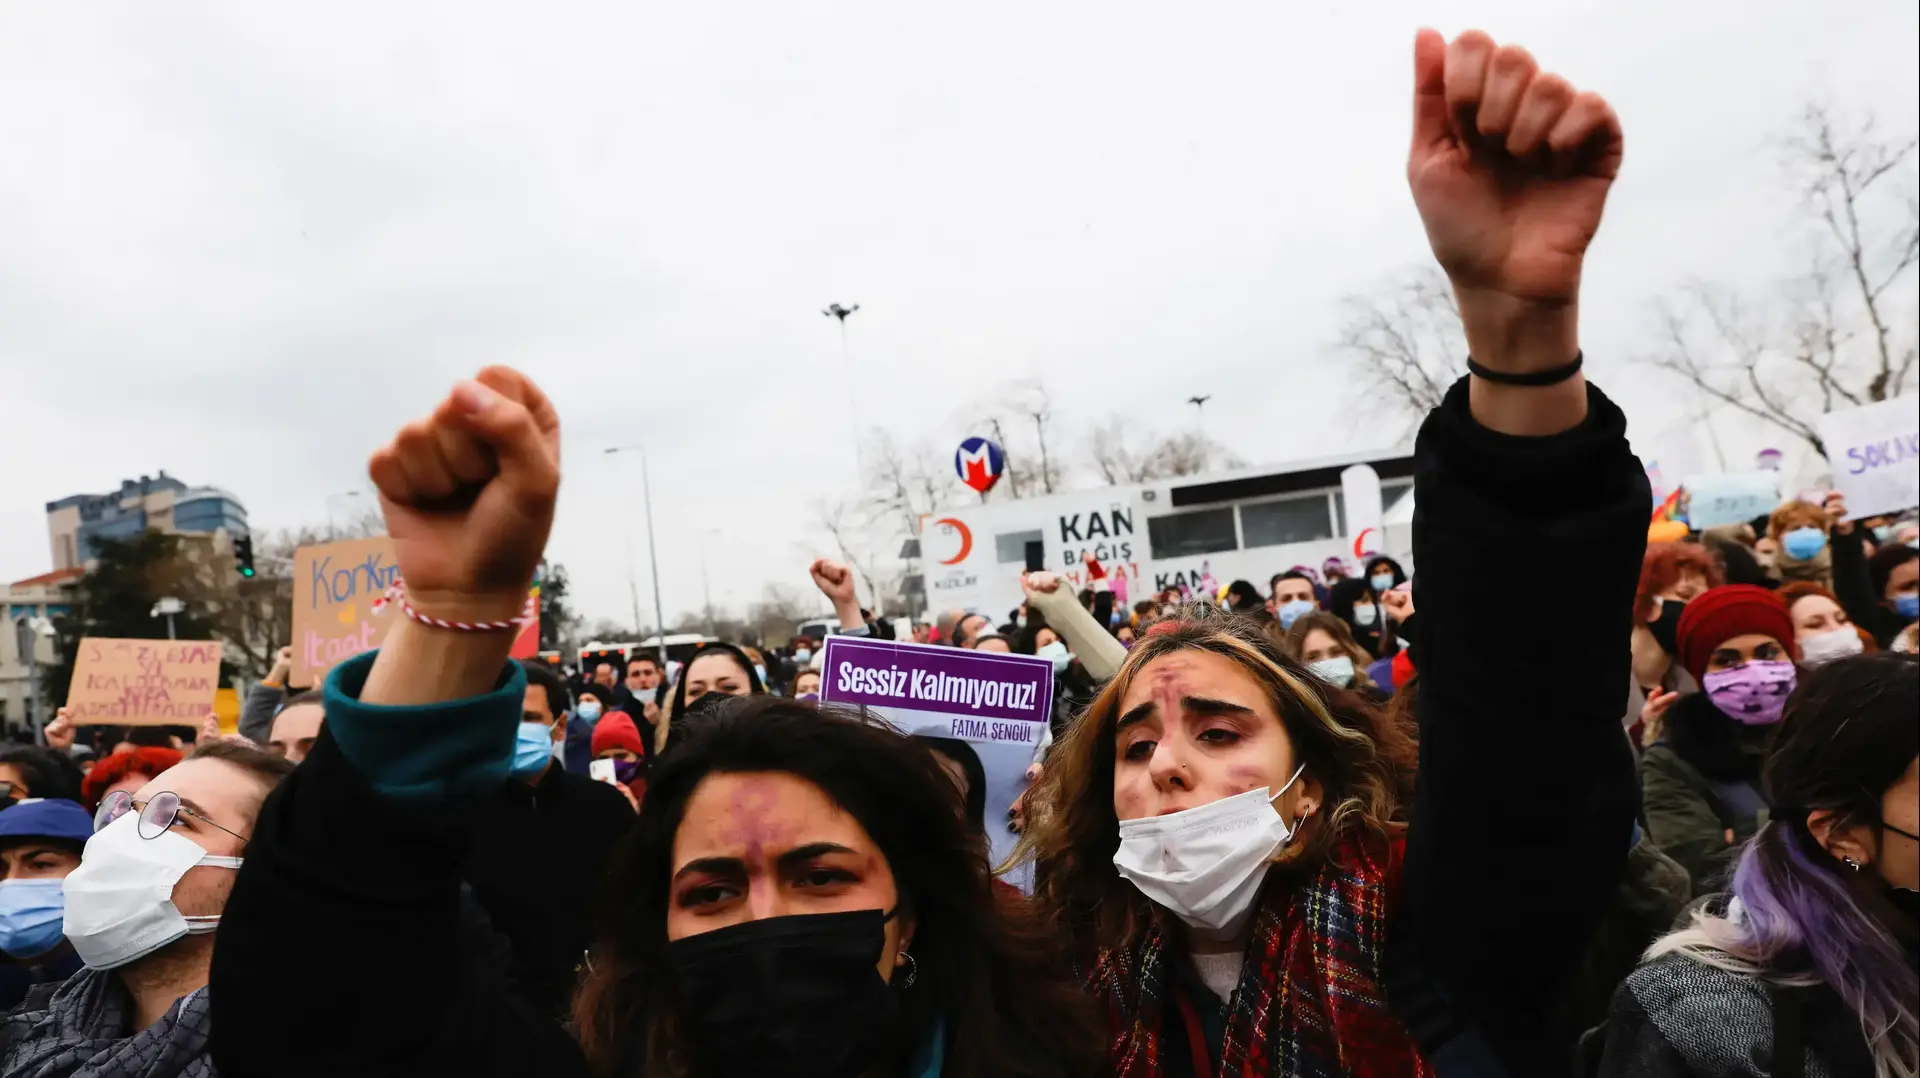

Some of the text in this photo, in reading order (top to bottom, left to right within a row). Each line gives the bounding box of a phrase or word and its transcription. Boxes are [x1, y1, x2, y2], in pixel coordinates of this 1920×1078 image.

[1060, 508, 1133, 543] KAN
[1066, 563, 1138, 586] HAT
[838, 661, 1037, 710] Sessiz Kalmıyoruz!
[951, 718, 1032, 742] FATMA ŞENGÜL
